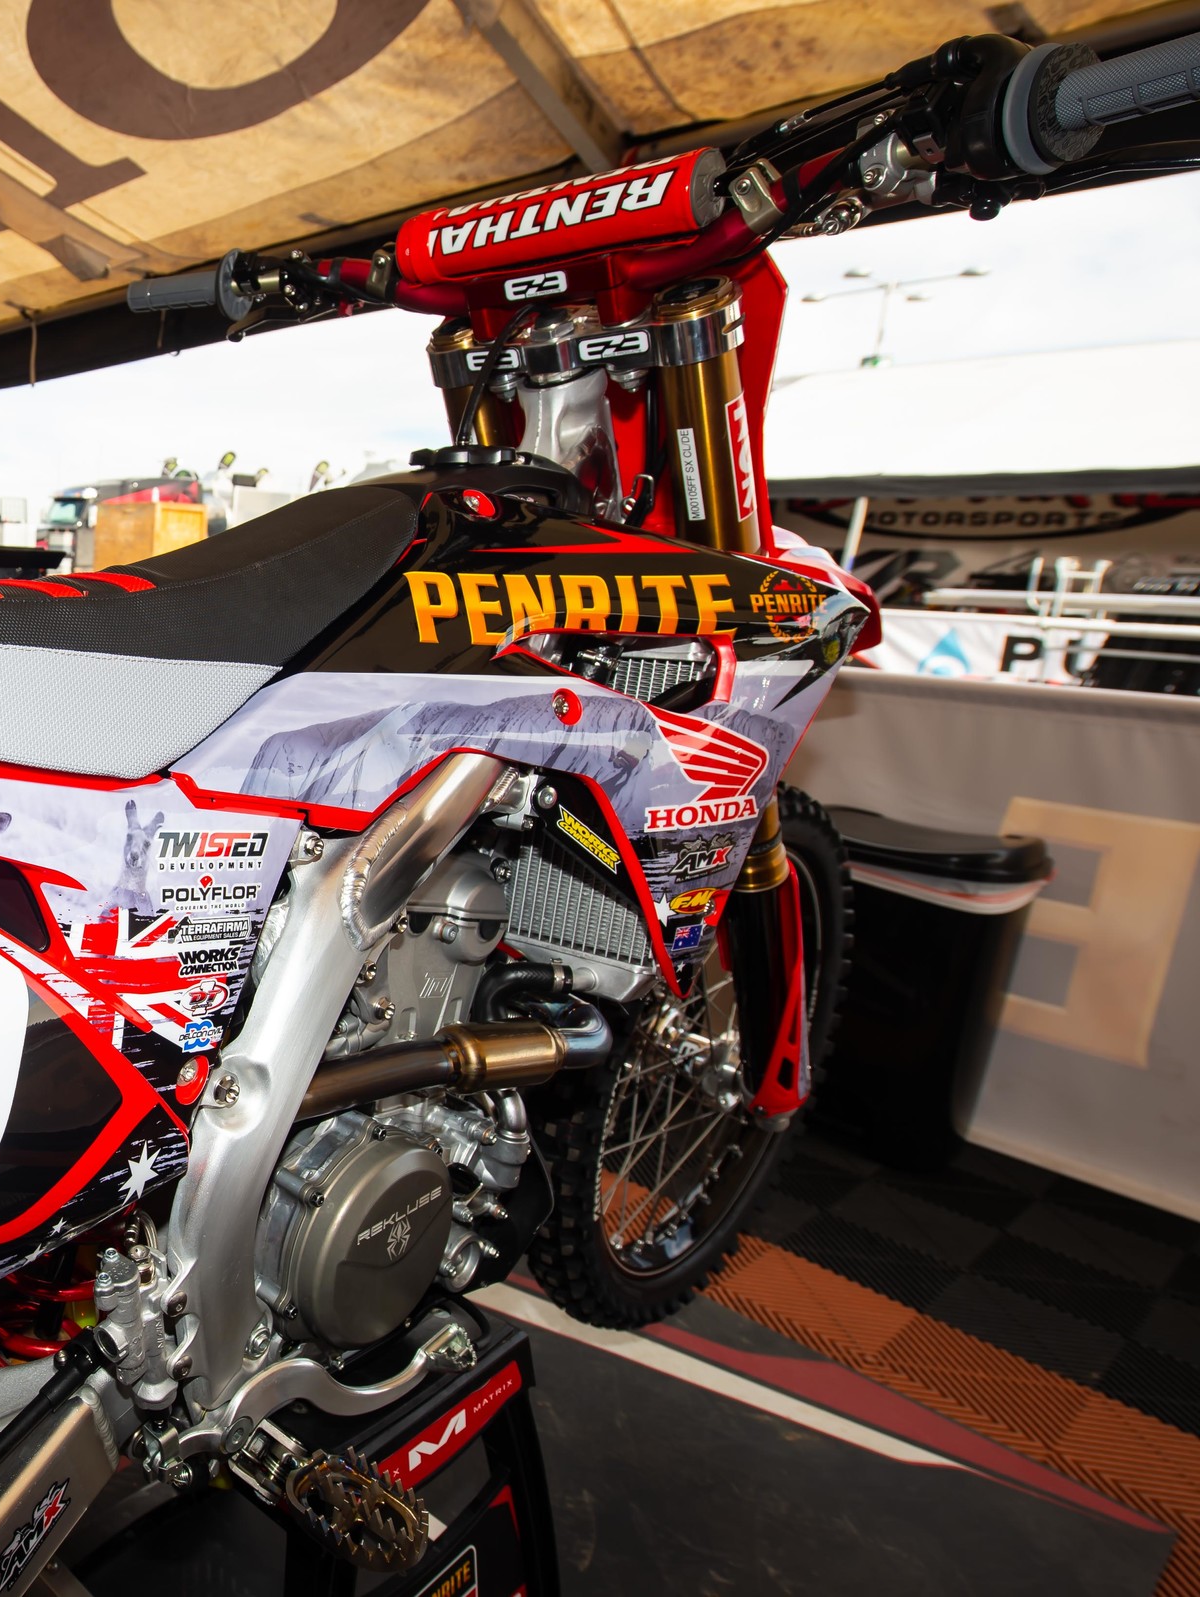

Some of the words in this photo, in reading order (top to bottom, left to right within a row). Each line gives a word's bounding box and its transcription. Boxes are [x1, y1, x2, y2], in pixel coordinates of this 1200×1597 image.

[684, 461, 695, 473] SX
[403, 570, 738, 646] PENRITE
[749, 593, 828, 613] PENRITE
[647, 799, 757, 829] HONDA
[158, 832, 269, 857] TWISTED
[559, 821, 615, 868] CONNECTION
[562, 810, 621, 862] WORKS
[160, 861, 262, 870] DEVELOPMENT
[671, 846, 735, 874] AMX
[162, 885, 257, 903] POLYFLOR
[181, 920, 248, 935] TERRAFIRMA
[193, 933, 222, 941] EQUIPMENT
[178, 947, 241, 964] WORKS
[180, 961, 237, 976] CONNECTION
[356, 1185, 442, 1246] REKLUSE
[472, 1379, 513, 1414] MATRIX
[432, 1560, 471, 1597] NRITE
